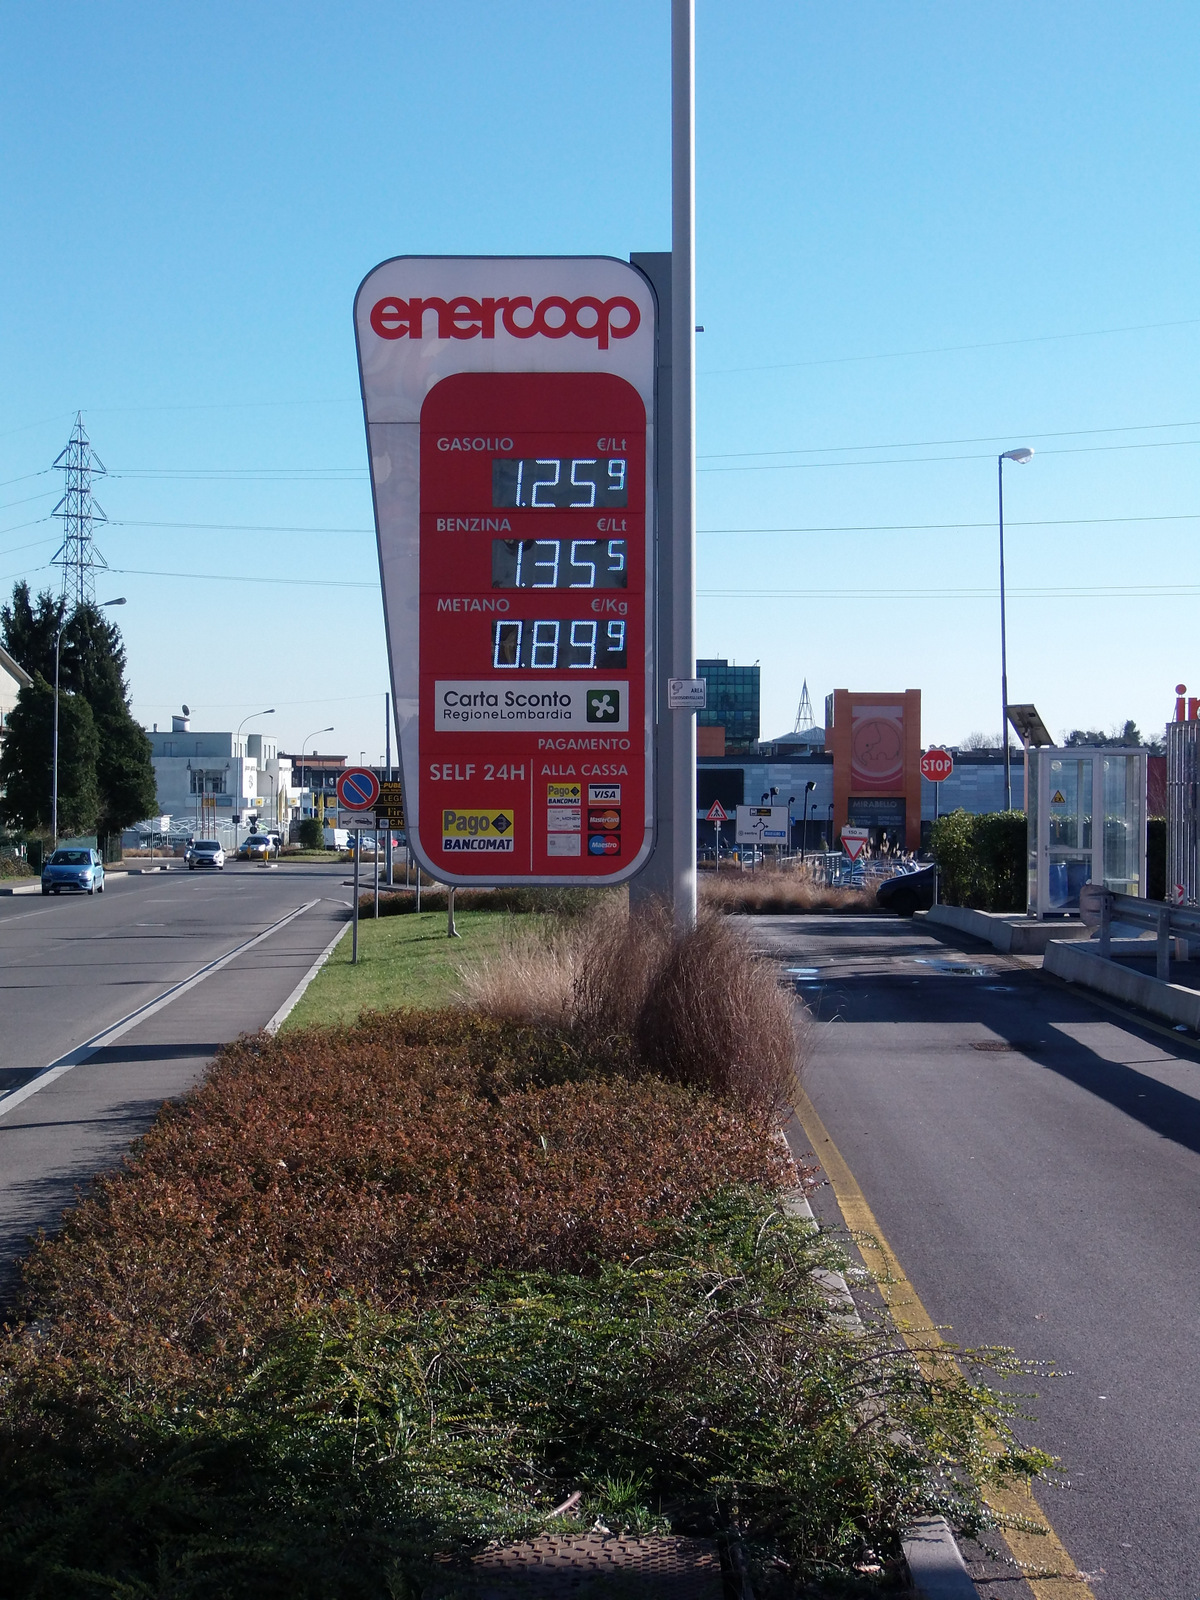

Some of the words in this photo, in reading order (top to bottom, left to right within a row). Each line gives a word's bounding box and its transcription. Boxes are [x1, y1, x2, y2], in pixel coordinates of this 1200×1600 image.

[370, 296, 641, 350] enercoop
[437, 438, 514, 452] GASOLIO
[597, 438, 627, 452] €/Lt
[436, 518, 512, 532] BENZINA
[597, 518, 627, 532] €/Lt
[437, 598, 510, 612] METANO
[591, 598, 629, 615] €/Kg
[443, 690, 499, 707] Carta
[504, 690, 572, 707] Sconto
[538, 738, 631, 750] PAGAMENTO
[430, 764, 476, 781] SELF
[483, 764, 525, 781] 24H
[541, 764, 576, 776] ALLA
[581, 764, 629, 776] CASSA
[922, 760, 950, 772] STOP
[548, 785, 570, 797] Pago
[594, 790, 616, 799] VISA
[443, 810, 490, 836] Pago
[443, 838, 513, 850] BANCOMAT
